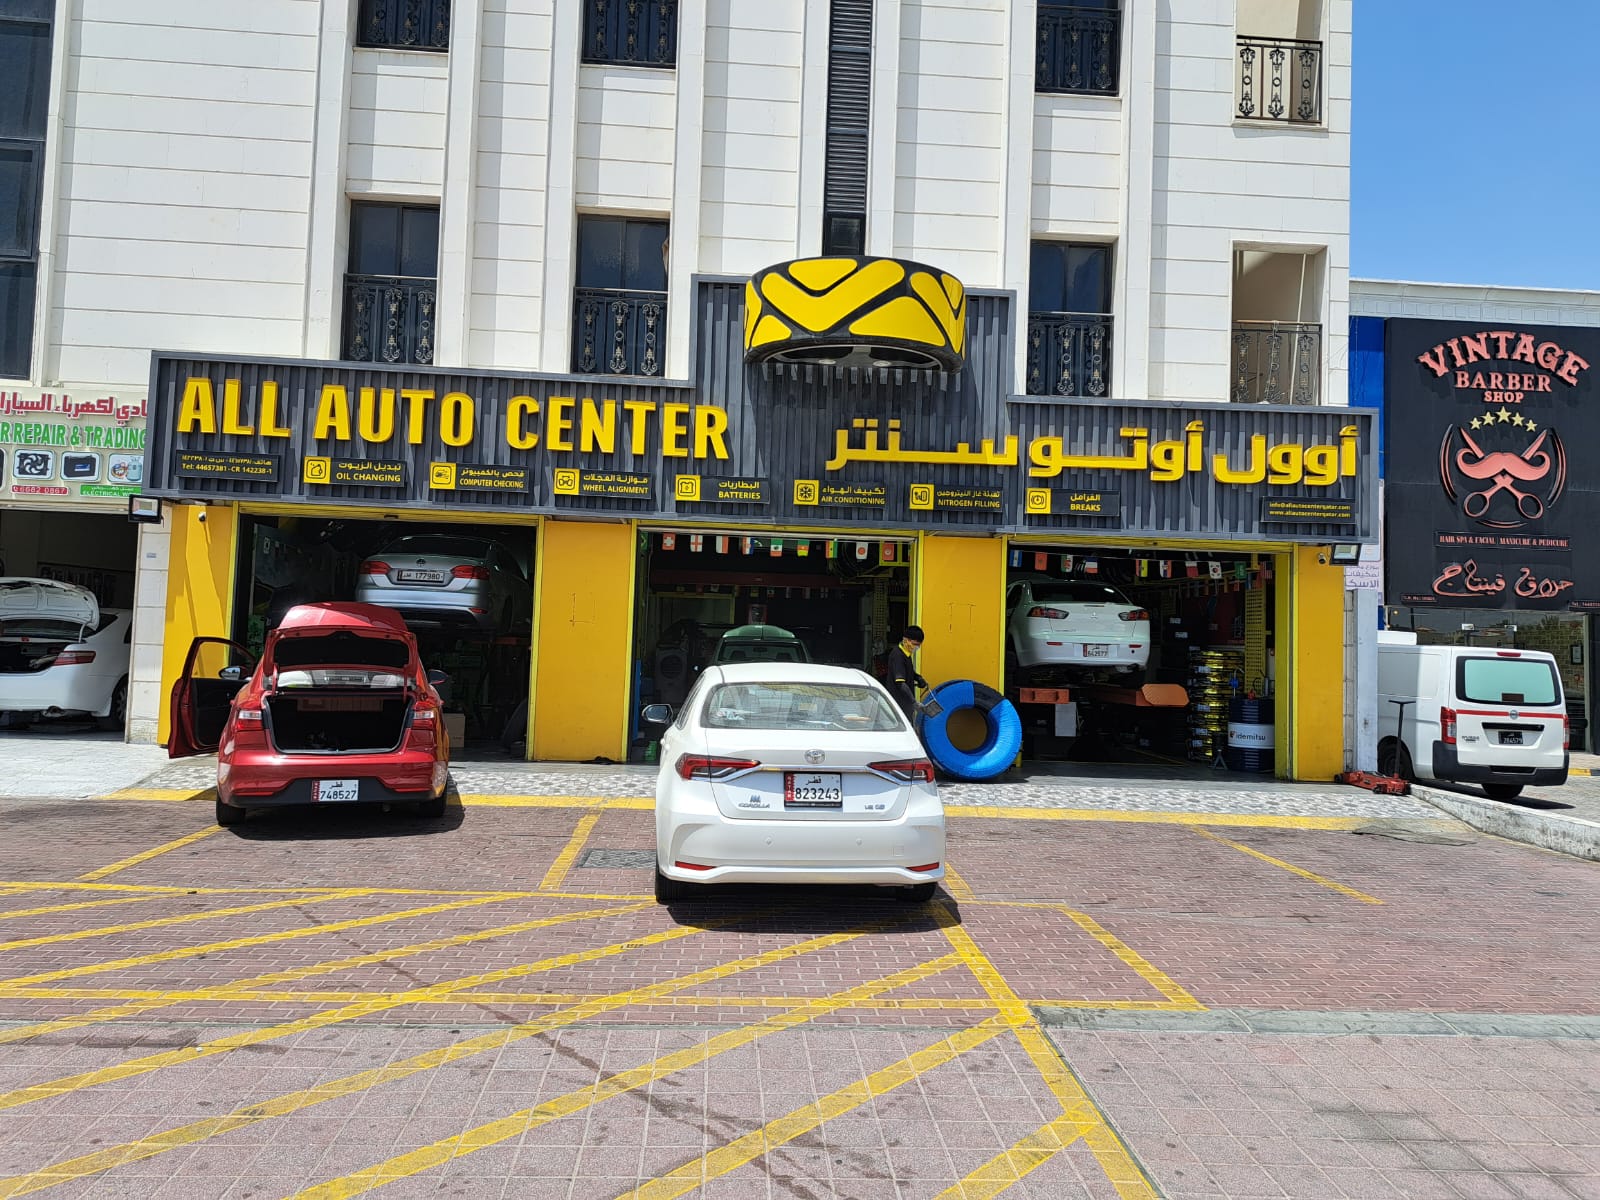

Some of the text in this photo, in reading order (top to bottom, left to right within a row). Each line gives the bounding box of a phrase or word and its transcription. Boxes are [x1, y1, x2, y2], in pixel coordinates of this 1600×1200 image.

[1417, 330, 1591, 387] VINTAGE
[1455, 370, 1553, 393] BARBER
[1483, 390, 1525, 404] SHOP
[0, 391, 52, 415] السيارا
[177, 377, 729, 459] ALL AUTO CENTER
[13, 422, 66, 446] REPAIR
[70, 425, 80, 447] &
[825, 418, 1359, 486] أوول أوتو سنتر
[338, 461, 401, 472] تبديل الزيوت
[336, 472, 401, 482] OIL CHANGING
[502, 470, 525, 478] فحص
[459, 478, 524, 489] COMPUTER CHECKING
[718, 480, 760, 490] البطاريات
[583, 484, 649, 494] WHEEL ALIGNMENT
[854, 486, 885, 496] تكييف
[718, 491, 761, 500] BATTERIES
[821, 495, 885, 505] AIR CONDITIONING
[1070, 492, 1101, 502] الفرامل
[938, 499, 1000, 509] NITROGEN FILLING
[1070, 503, 1102, 512] BREAKS
[1439, 535, 1455, 543] HAIR
[1500, 537, 1530, 546] MANICURE
[1538, 539, 1569, 547] PEDICURE
[1236, 732, 1266, 741] idemitsu
[320, 790, 357, 800] 748527
[795, 787, 840, 800] 823243
